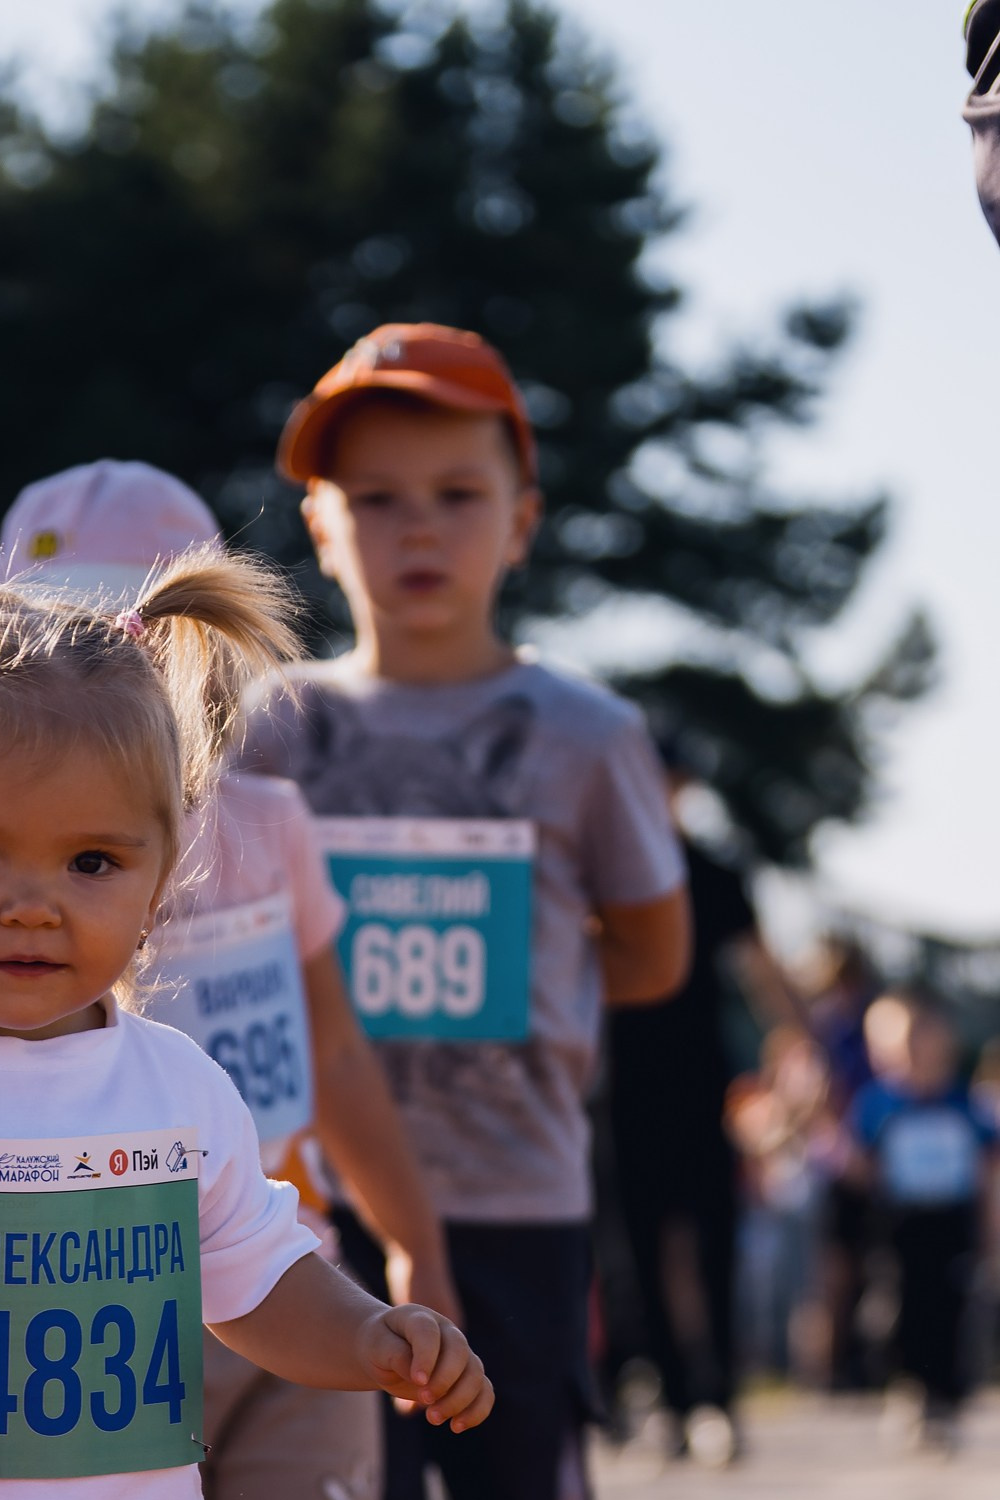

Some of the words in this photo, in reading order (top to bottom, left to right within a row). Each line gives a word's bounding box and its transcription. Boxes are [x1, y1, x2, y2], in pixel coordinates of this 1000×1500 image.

[353, 923, 486, 1018] 689
[16, 1153, 60, 1164] КАЛУЖСКИЙ
[132, 1148, 159, 1172] Пэй
